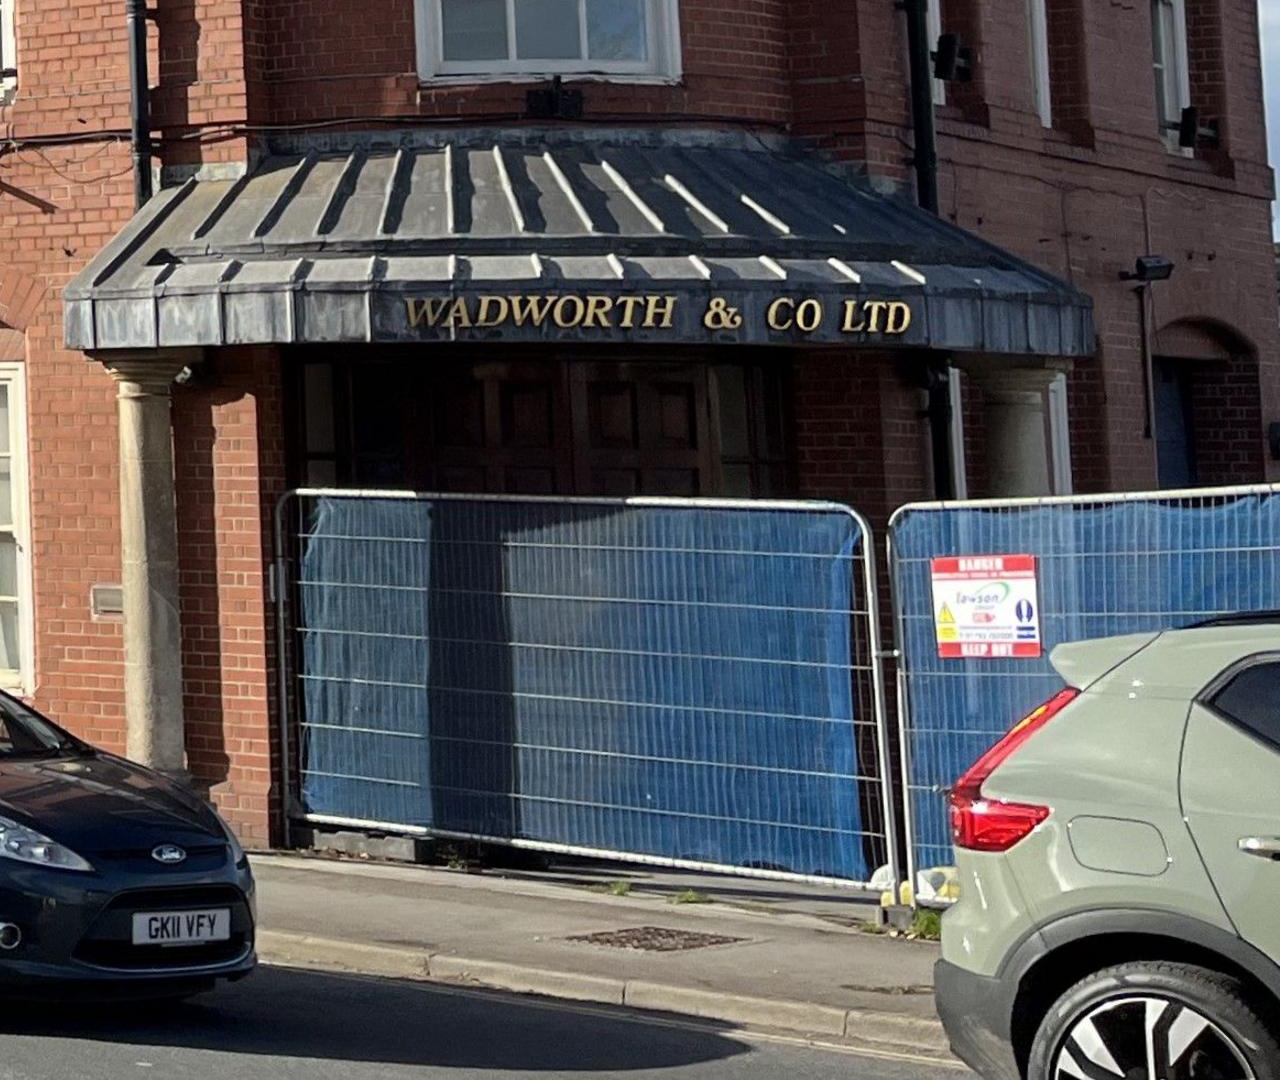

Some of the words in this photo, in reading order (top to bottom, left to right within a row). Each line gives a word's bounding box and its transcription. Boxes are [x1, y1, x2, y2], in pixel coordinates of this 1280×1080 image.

[404, 294, 679, 329] WADWORTH
[703, 297, 743, 330] &
[767, 297, 822, 331] CO
[841, 299, 912, 334] LTD
[148, 916, 181, 939] GK11
[186, 913, 217, 937] VFY
